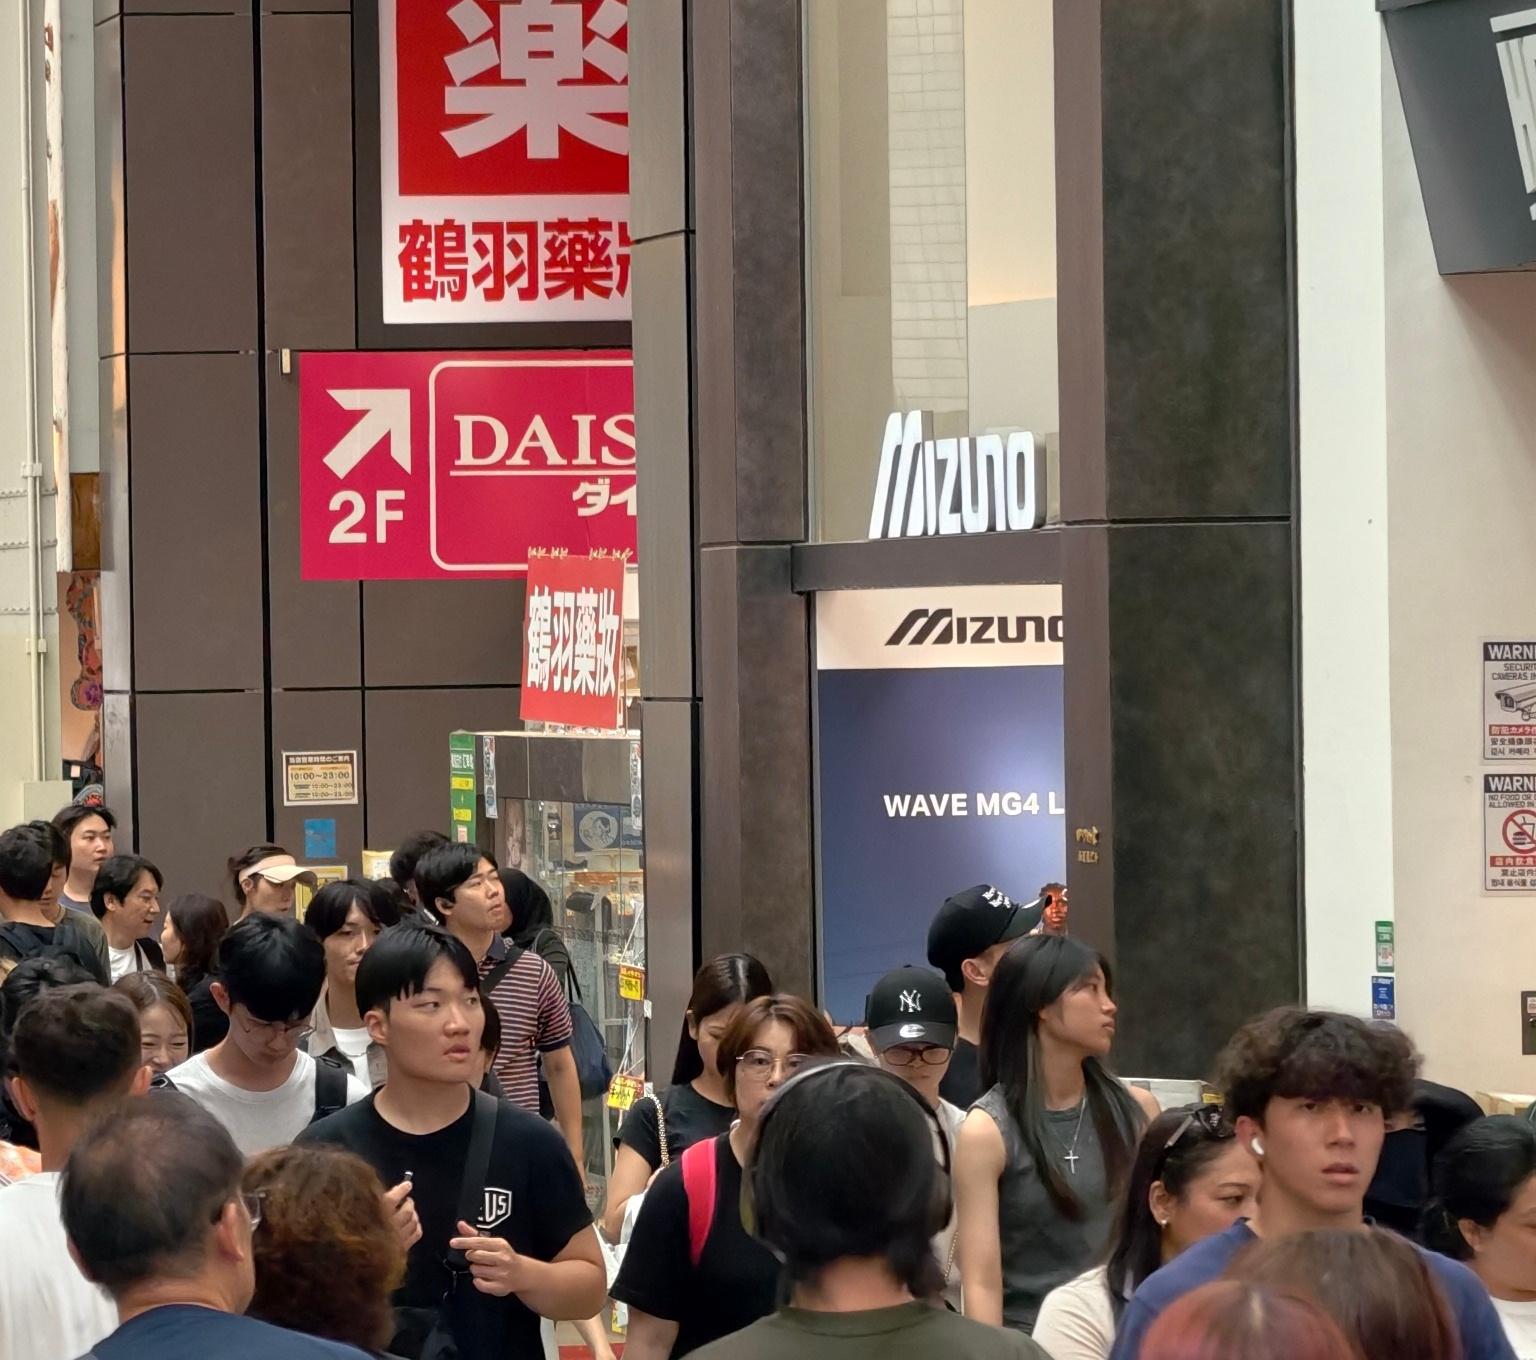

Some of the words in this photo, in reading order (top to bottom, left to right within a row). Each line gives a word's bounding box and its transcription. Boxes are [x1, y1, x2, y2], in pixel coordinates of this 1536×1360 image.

[870, 410, 1038, 538] MIZUNO
[328, 491, 405, 544] 2F
[884, 794, 967, 817] WAVE
[977, 793, 1040, 816] MG4
